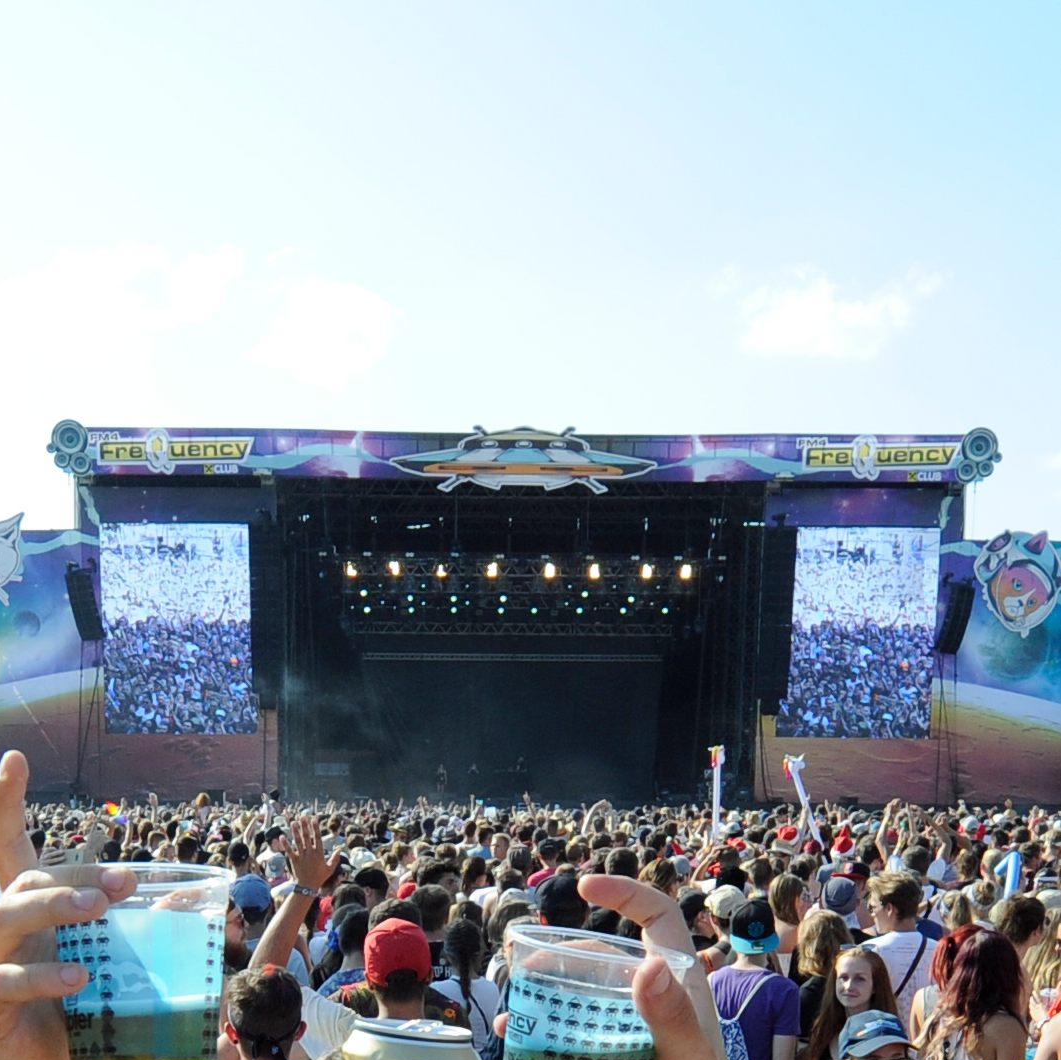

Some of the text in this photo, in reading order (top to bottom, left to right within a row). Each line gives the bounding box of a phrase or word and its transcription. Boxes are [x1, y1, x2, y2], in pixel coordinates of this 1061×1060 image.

[99, 432, 251, 470] FreQuency
[806, 438, 956, 477] FreQuency
[213, 464, 239, 474] CLUB
[917, 471, 942, 482] CLUB
